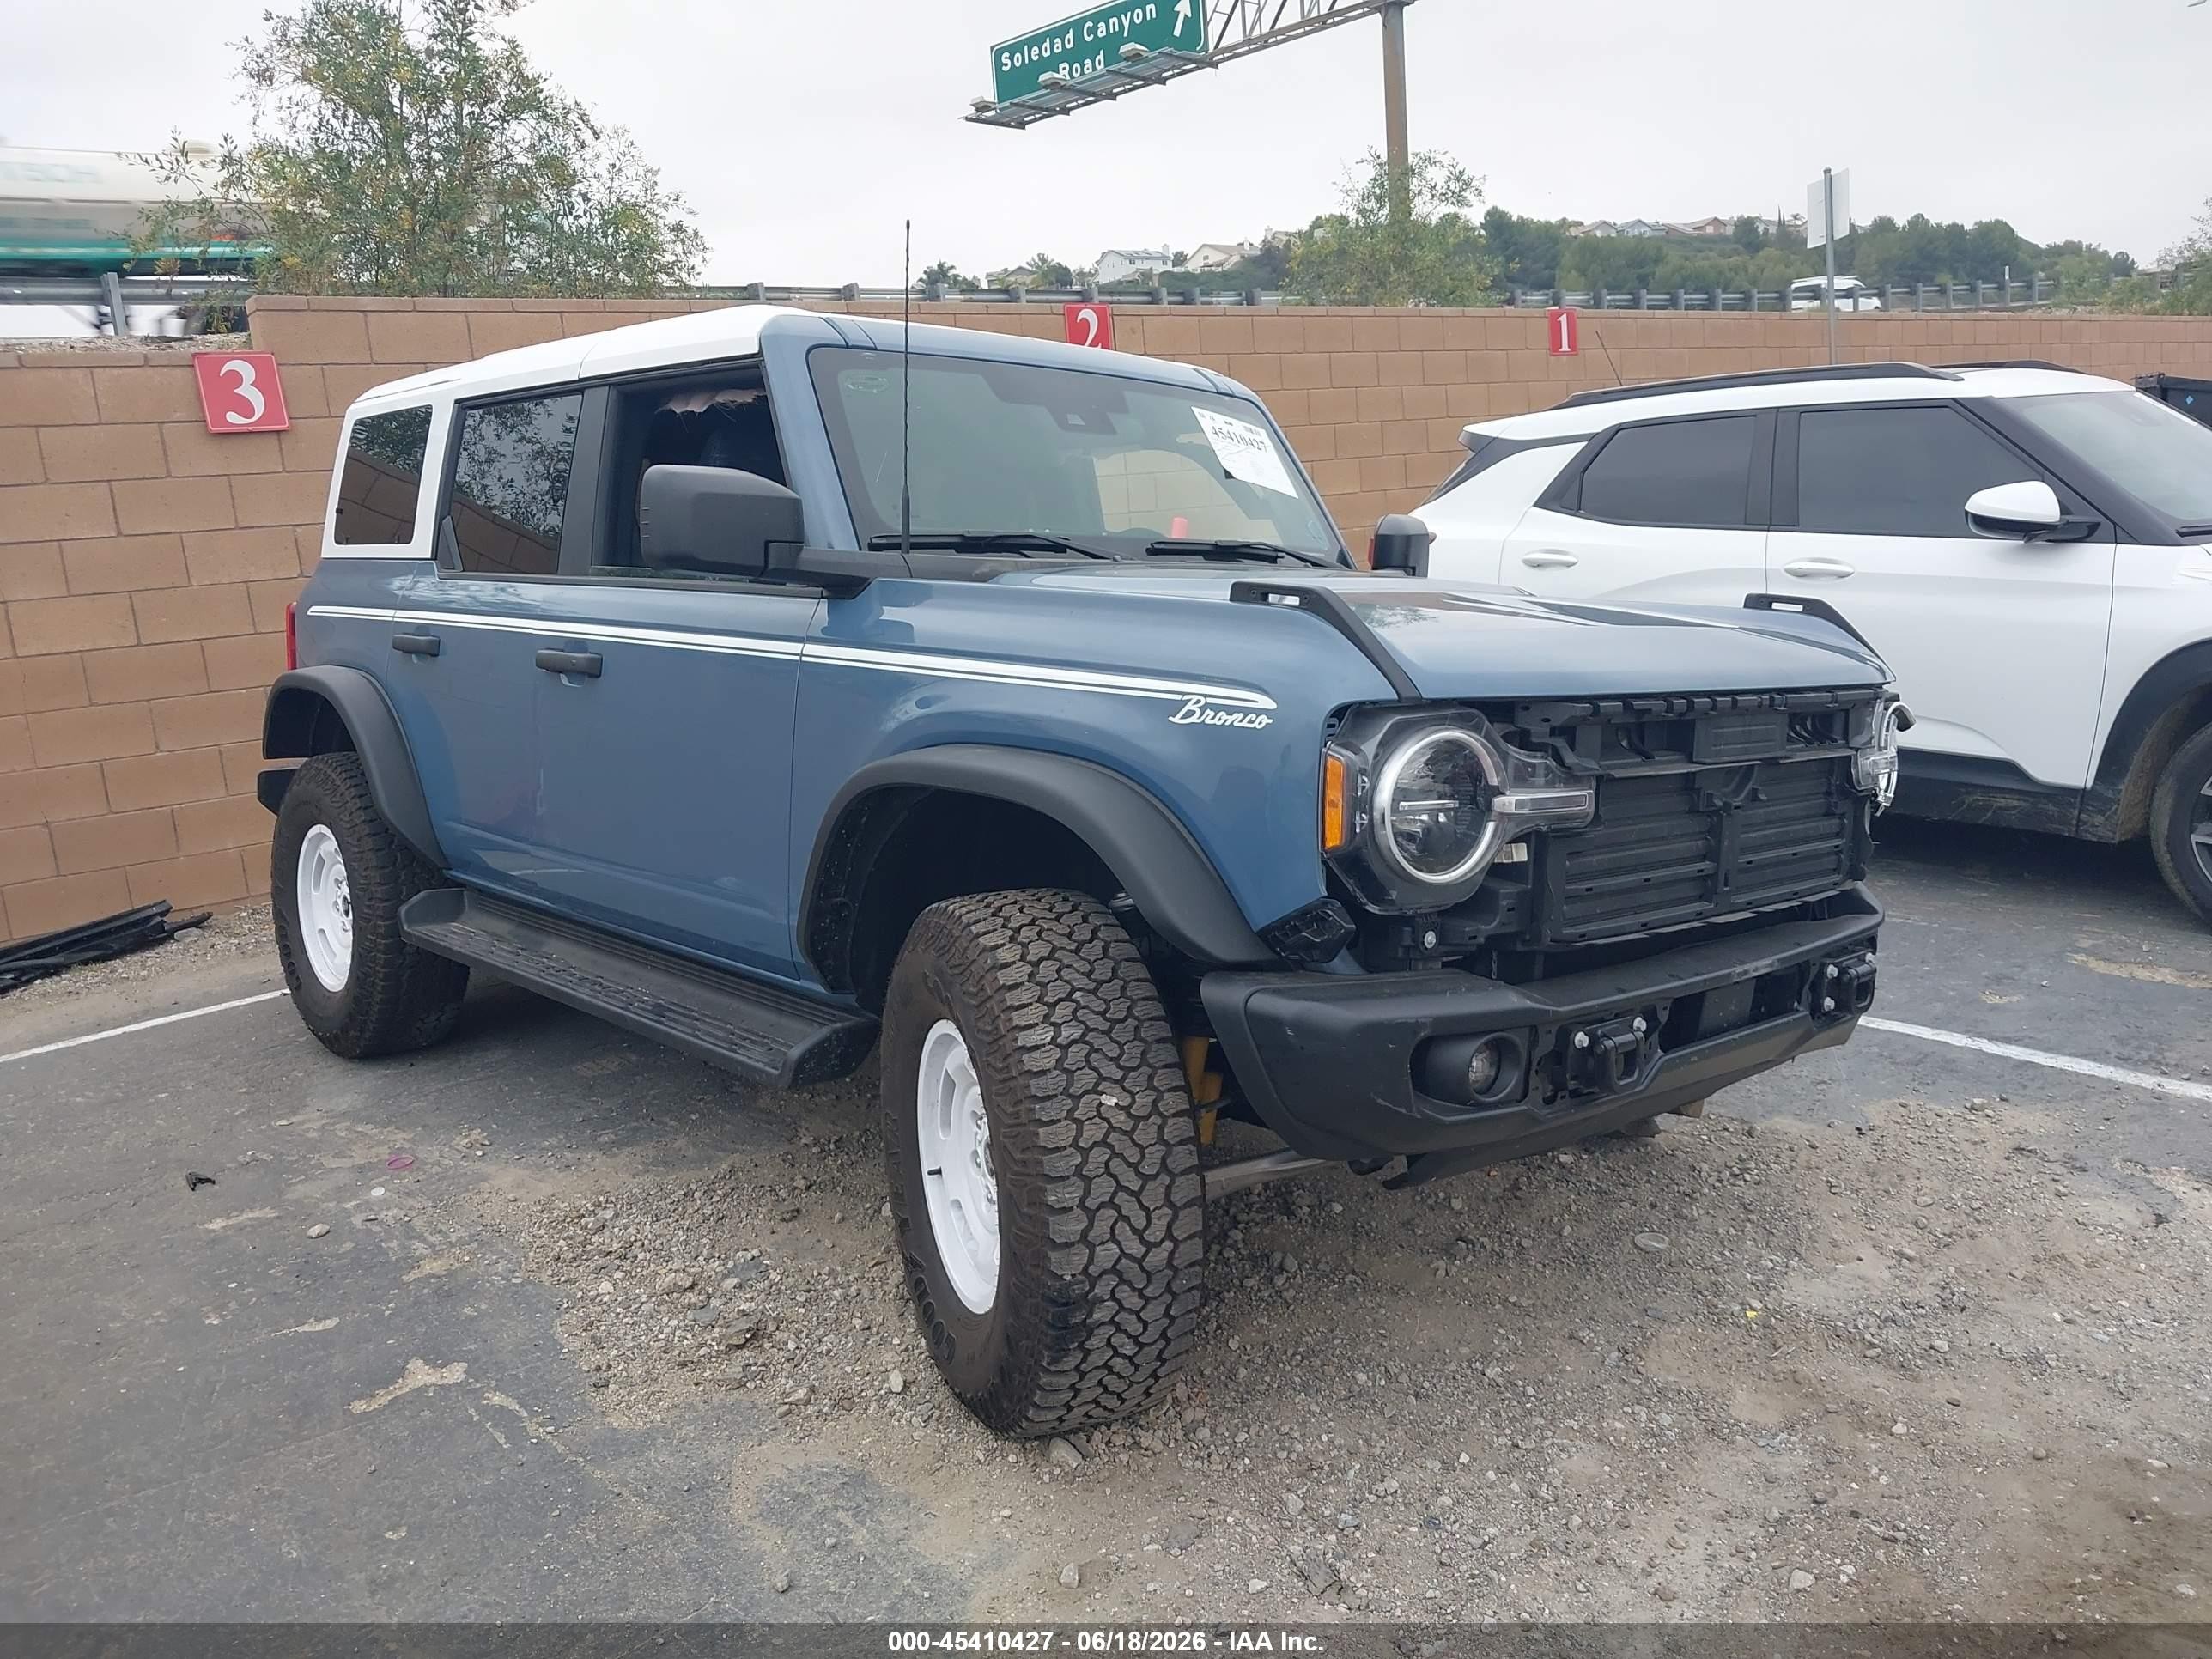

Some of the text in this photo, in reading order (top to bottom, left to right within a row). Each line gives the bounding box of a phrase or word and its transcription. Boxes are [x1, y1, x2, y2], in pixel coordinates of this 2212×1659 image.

[1001, 2, 1158, 72] Soledad Canyon
[1058, 50, 1105, 79] Road
[1076, 308, 1102, 349] 2
[1557, 313, 1571, 351] 1
[219, 359, 265, 424] 3
[1212, 425, 1267, 453] 45410427
[1168, 694, 1273, 729] Bronco
